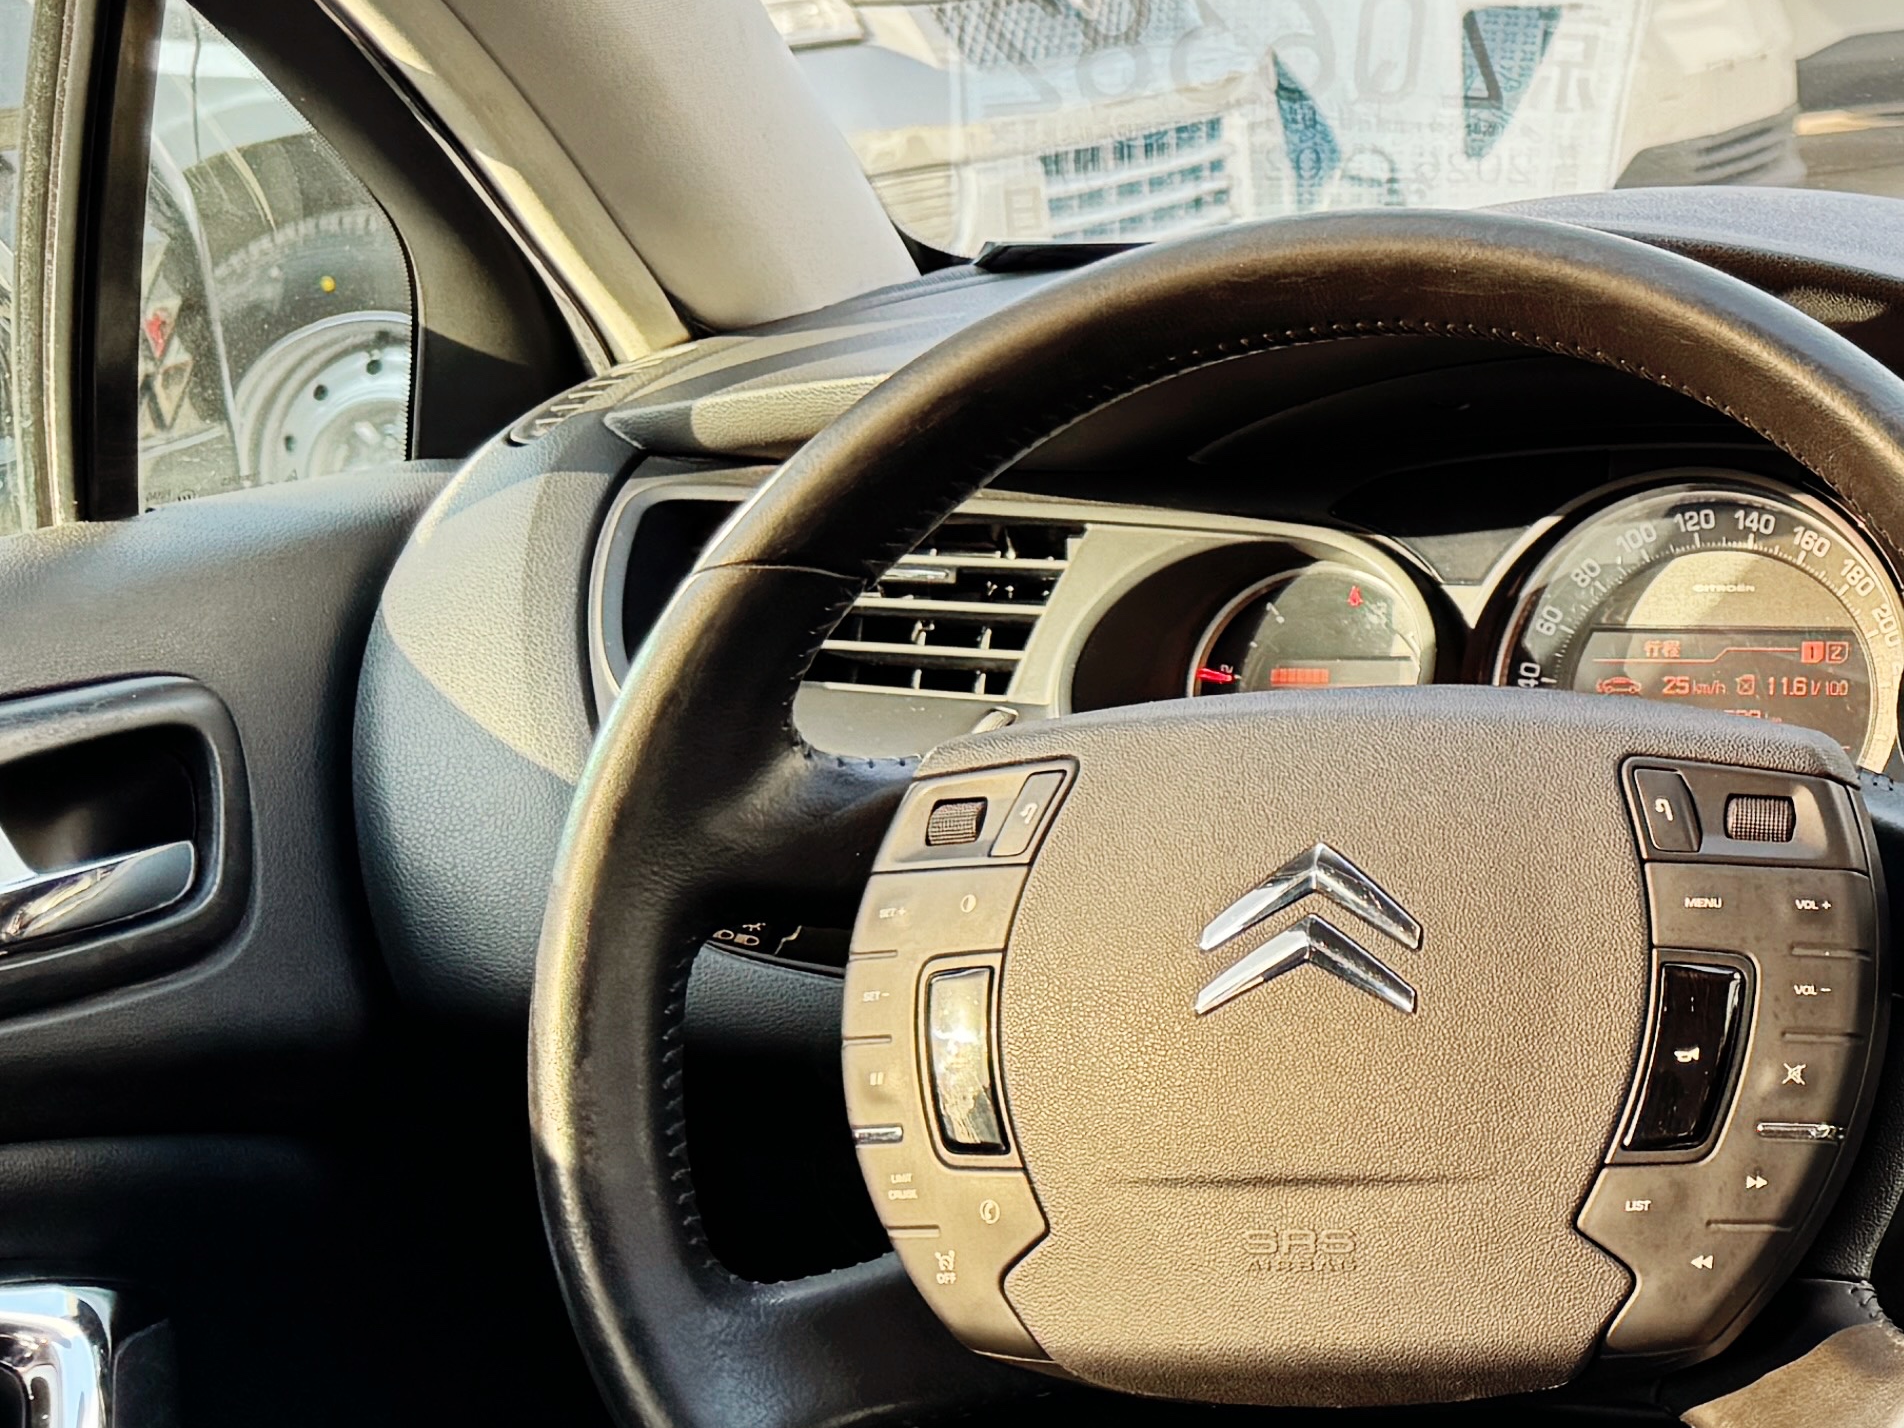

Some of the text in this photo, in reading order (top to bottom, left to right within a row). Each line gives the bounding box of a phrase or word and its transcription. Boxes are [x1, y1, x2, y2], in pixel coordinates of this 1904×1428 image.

[1675, 508, 1715, 533] 120
[1734, 509, 1775, 535] 140
[1616, 522, 1657, 553] 100
[1793, 525, 1831, 559] 160
[1571, 557, 1602, 588] 80
[1840, 558, 1874, 598] 180
[1535, 606, 1563, 637] 60
[1873, 603, 1899, 648] 200
[1663, 675, 1690, 695] 25
[1767, 676, 1806, 697] 11.6
[1684, 898, 1723, 910] MENU
[1625, 1200, 1651, 1211] LIST
[1243, 1228, 1358, 1255] SRS
[936, 1272, 957, 1284] OFF
